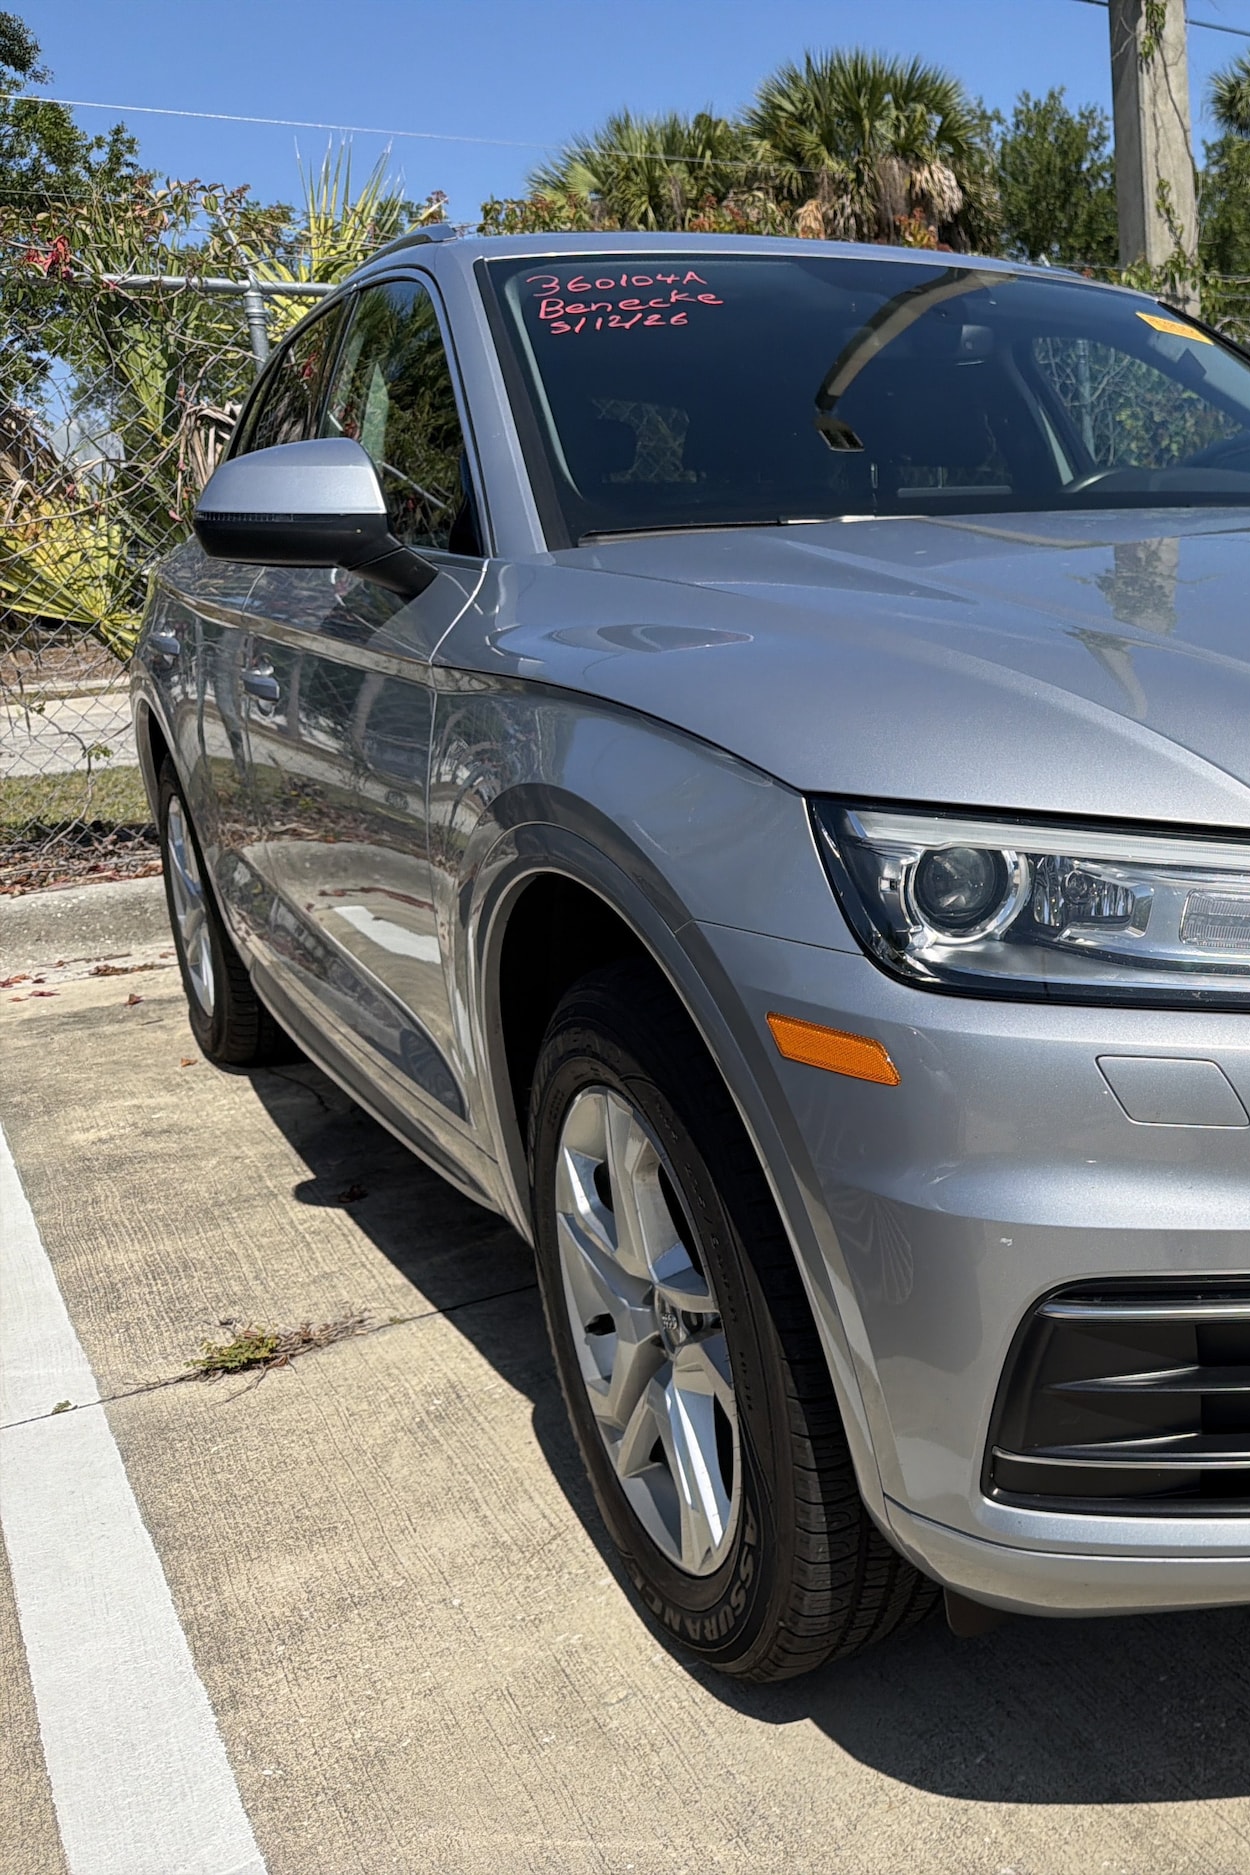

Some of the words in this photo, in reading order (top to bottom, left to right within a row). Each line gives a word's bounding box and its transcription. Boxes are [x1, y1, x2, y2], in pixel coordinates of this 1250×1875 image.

[526, 271, 708, 297] 360104A
[538, 290, 724, 320] Benecke
[550, 312, 689, 335] 5/12/26
